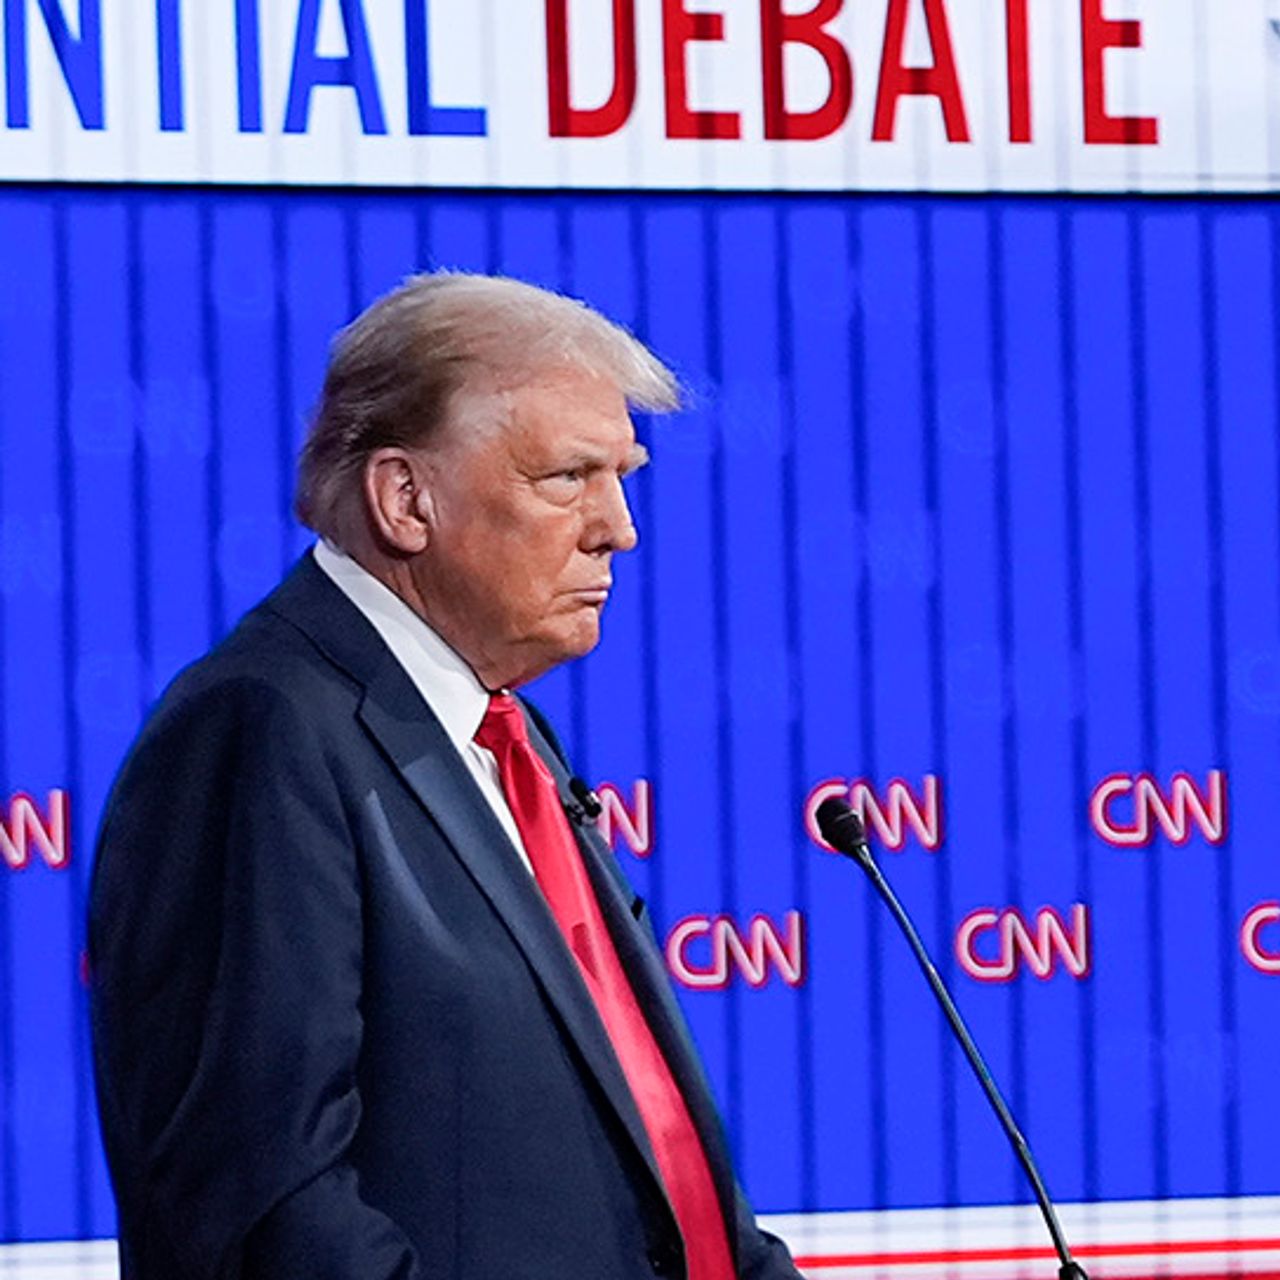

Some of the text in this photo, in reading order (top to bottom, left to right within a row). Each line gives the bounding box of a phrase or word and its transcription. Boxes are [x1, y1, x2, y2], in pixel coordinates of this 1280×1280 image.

[1089, 769, 1227, 848] CNN
[666, 910, 803, 991] CNN
[955, 903, 1090, 983] CNN
